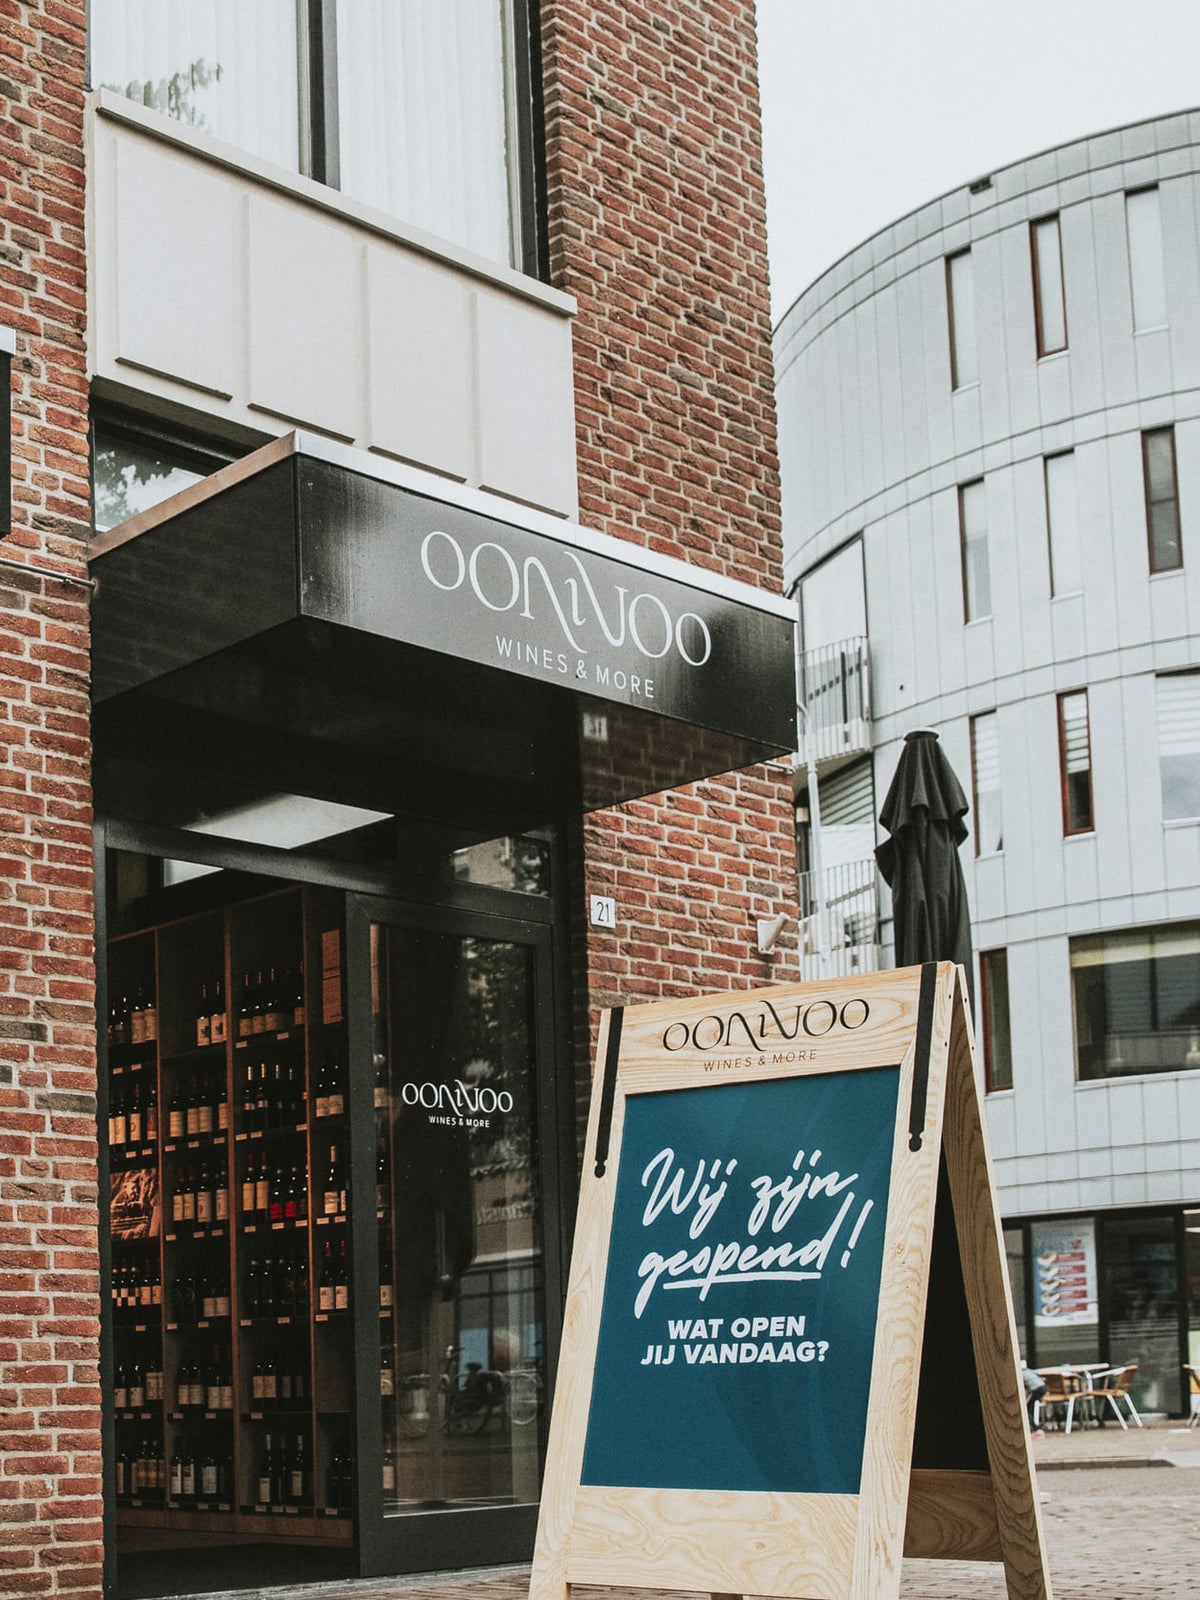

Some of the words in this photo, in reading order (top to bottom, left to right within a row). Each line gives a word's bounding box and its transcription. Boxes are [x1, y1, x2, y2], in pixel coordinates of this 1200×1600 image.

[495, 635, 568, 673] WINES
[576, 659, 587, 679] &
[596, 664, 654, 699] MORE
[596, 901, 610, 923] 21
[703, 1056, 752, 1072] WINES
[757, 1055, 767, 1066] &
[772, 1049, 818, 1065] MORE
[428, 1115, 457, 1126] WINES
[458, 1117, 464, 1126] &
[465, 1118, 490, 1128] MORE
[641, 1147, 738, 1240] Wij
[747, 1149, 859, 1237] zijn
[634, 1191, 874, 1319] geopend!
[667, 1318, 724, 1340] WAT
[730, 1315, 806, 1338] OPEN
[640, 1345, 676, 1366] JIJ
[684, 1340, 830, 1365] VANDAAG?
